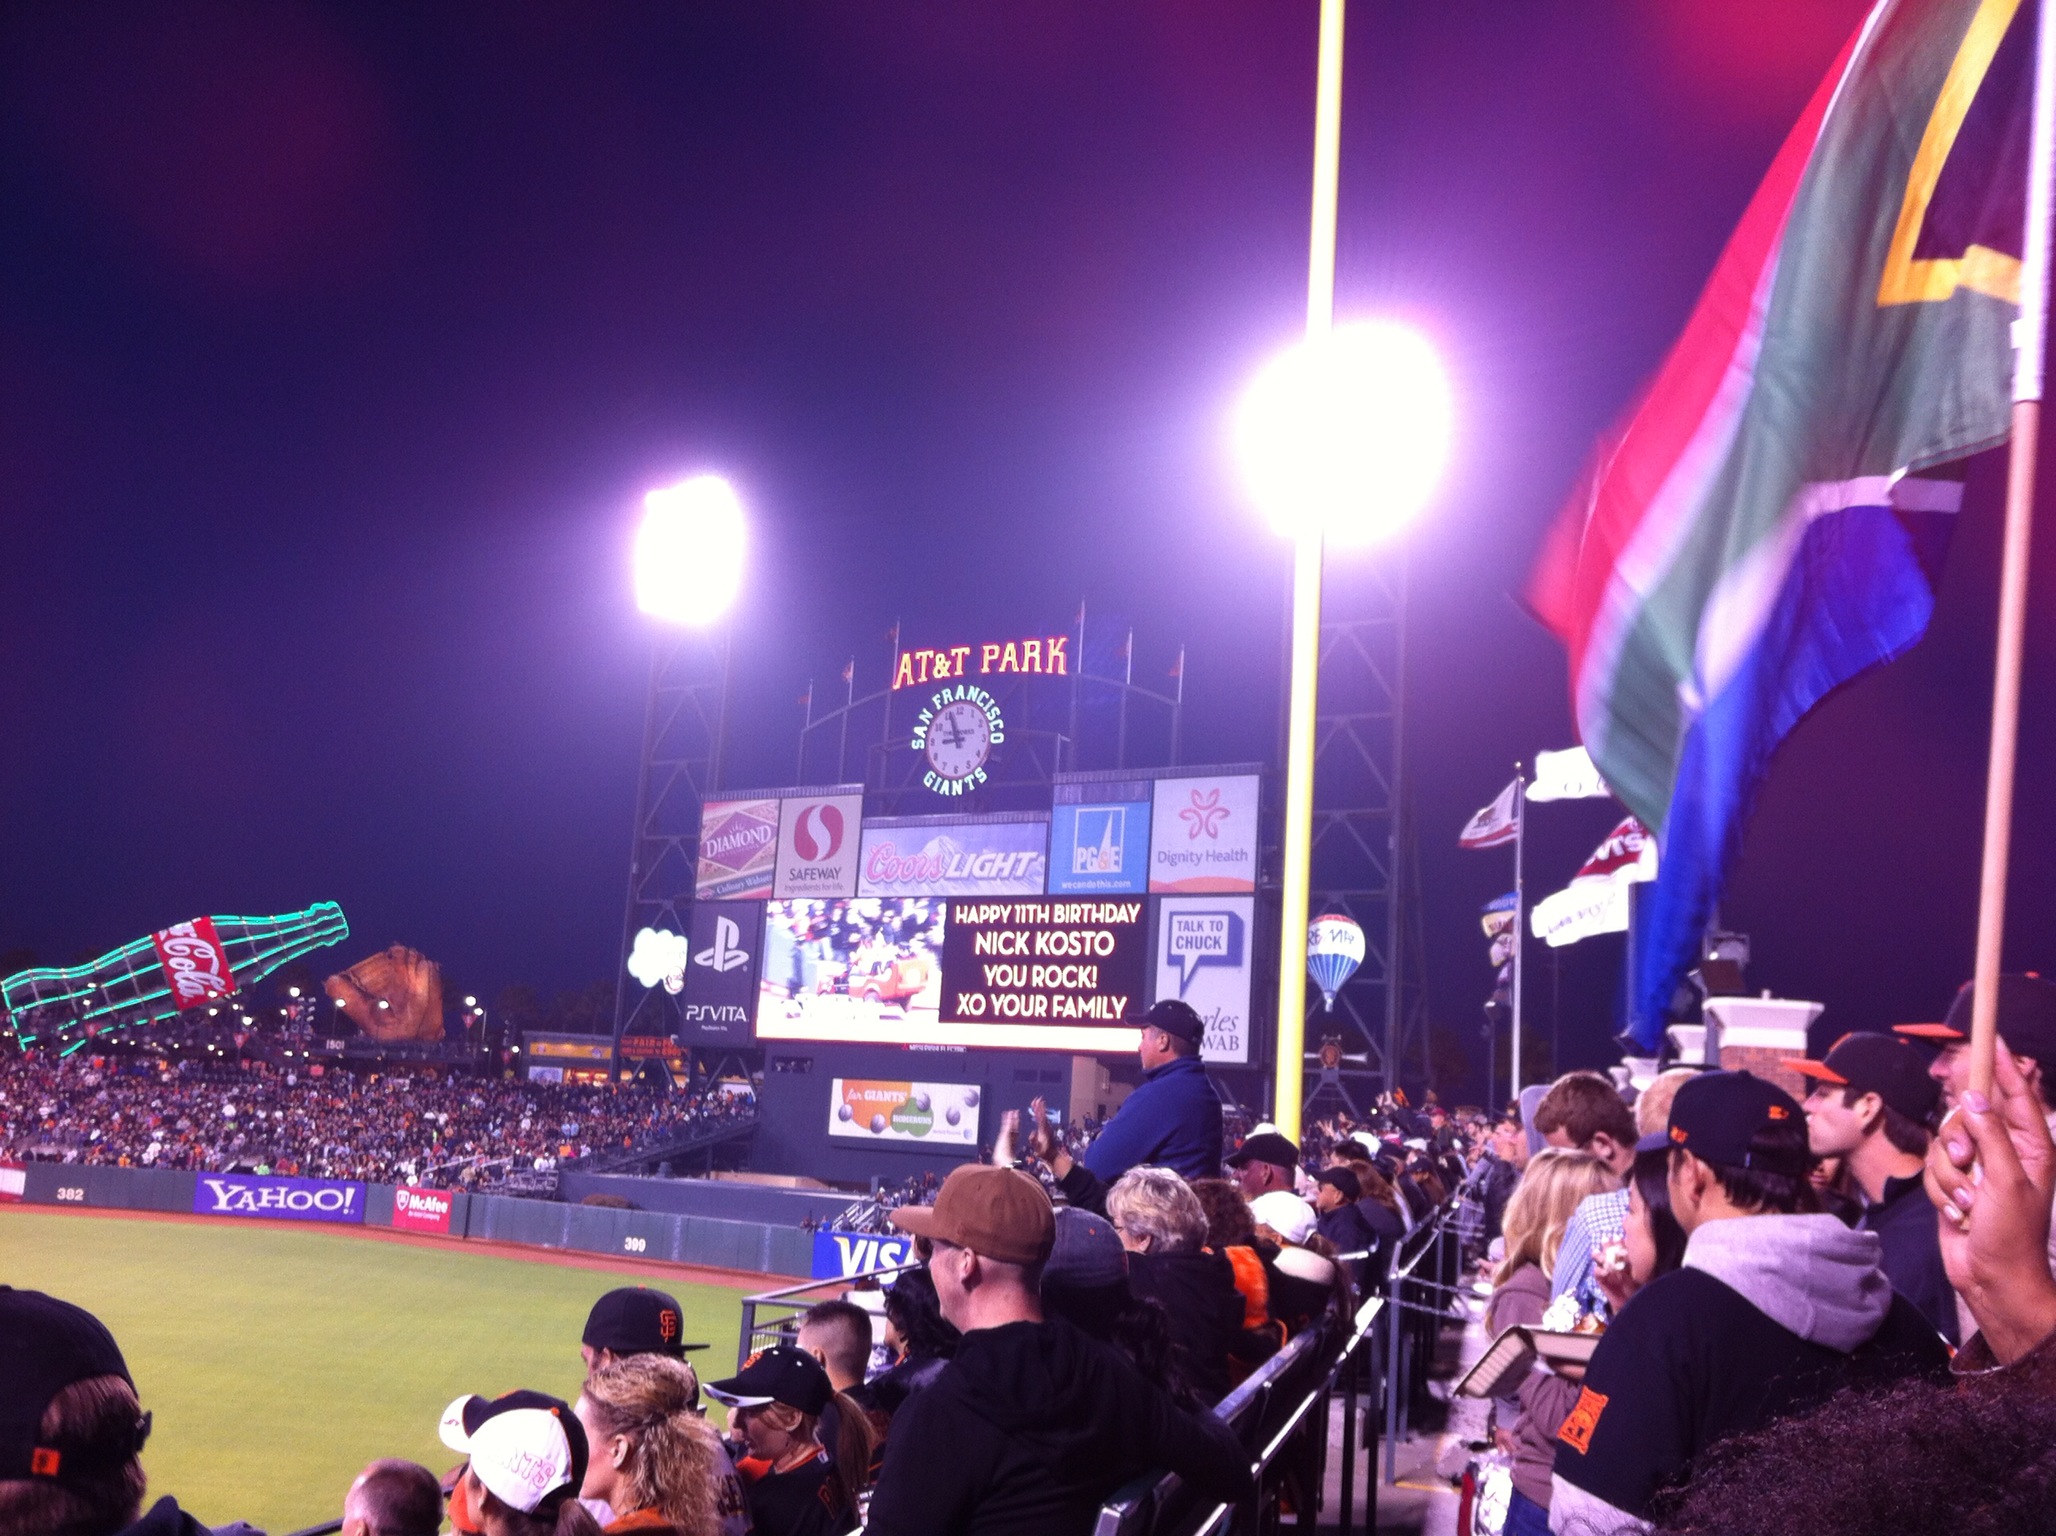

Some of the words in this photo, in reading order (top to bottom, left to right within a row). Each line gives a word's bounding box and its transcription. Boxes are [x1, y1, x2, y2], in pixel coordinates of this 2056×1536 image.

[892, 647, 970, 690] AT&T
[980, 636, 1068, 675] PARK
[911, 708, 934, 750] SAN
[932, 684, 1004, 744] FRANCISCO
[923, 766, 987, 796] GIANTS
[706, 825, 772, 858] DIAMOND
[866, 841, 944, 884] Coors
[944, 852, 1039, 880] LIGHT
[1076, 845, 1121, 871] PG&E
[1157, 849, 1202, 866] Dignity
[1205, 848, 1248, 862] Health
[789, 867, 842, 881] SAFEWAY
[955, 904, 1012, 924] HAPPY
[1015, 904, 1050, 924] 11TH
[1053, 903, 1142, 924] BIRTHDAY
[1177, 920, 1204, 933] TALK
[1210, 920, 1223, 932] TO
[975, 931, 1030, 956] NICK
[1035, 931, 1115, 956] KOSTO
[1175, 935, 1222, 950] CHUCK
[984, 964, 1027, 987] YOU
[1032, 965, 1098, 989] ROCK!
[957, 993, 987, 1016] XO
[991, 993, 1048, 1018] YOUR
[1052, 995, 1128, 1020] FAMILY
[1203, 1007, 1239, 1032] rles
[1201, 1035, 1239, 1051] WAB
[56, 1187, 84, 1201] 382
[203, 1179, 355, 1215] YAHOO!
[409, 1194, 448, 1214] McAfee
